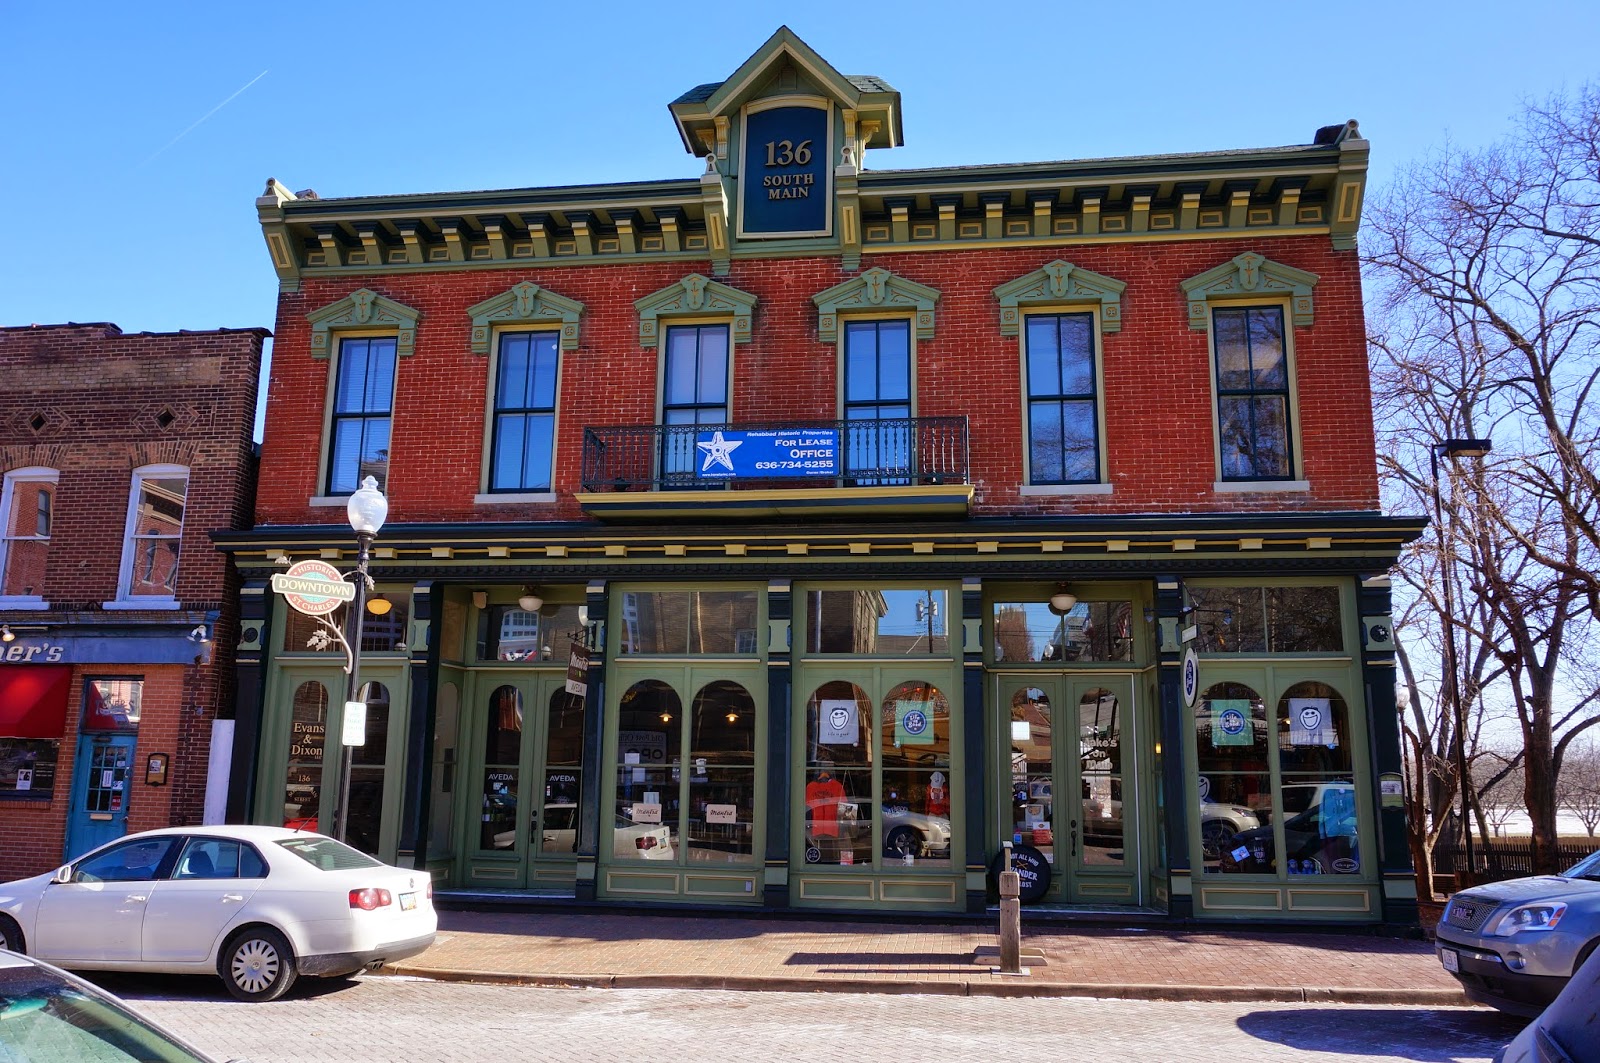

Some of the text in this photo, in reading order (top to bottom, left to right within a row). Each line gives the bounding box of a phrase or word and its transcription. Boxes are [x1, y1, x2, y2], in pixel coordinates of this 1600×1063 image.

[764, 139, 812, 166] 136
[763, 173, 814, 187] SOUTH
[768, 187, 809, 200] MAIN
[775, 438, 833, 447] FOR LEASE
[790, 449, 833, 458] OFFICE
[755, 460, 834, 470] 636-734-5255
[297, 564, 335, 577] HISTORIC
[278, 578, 350, 596] DOWNTOWN
[302, 600, 335, 611] CHARLES
[0, 643, 64, 662] er's
[293, 722, 325, 733] Evans
[302, 733, 313, 744] &
[291, 744, 323, 756] Dixon
[1092, 750, 1106, 758] on
[1018, 853, 1028, 861] ALL
[1028, 856, 1040, 867] WHO
[1453, 906, 1473, 919] GMC
